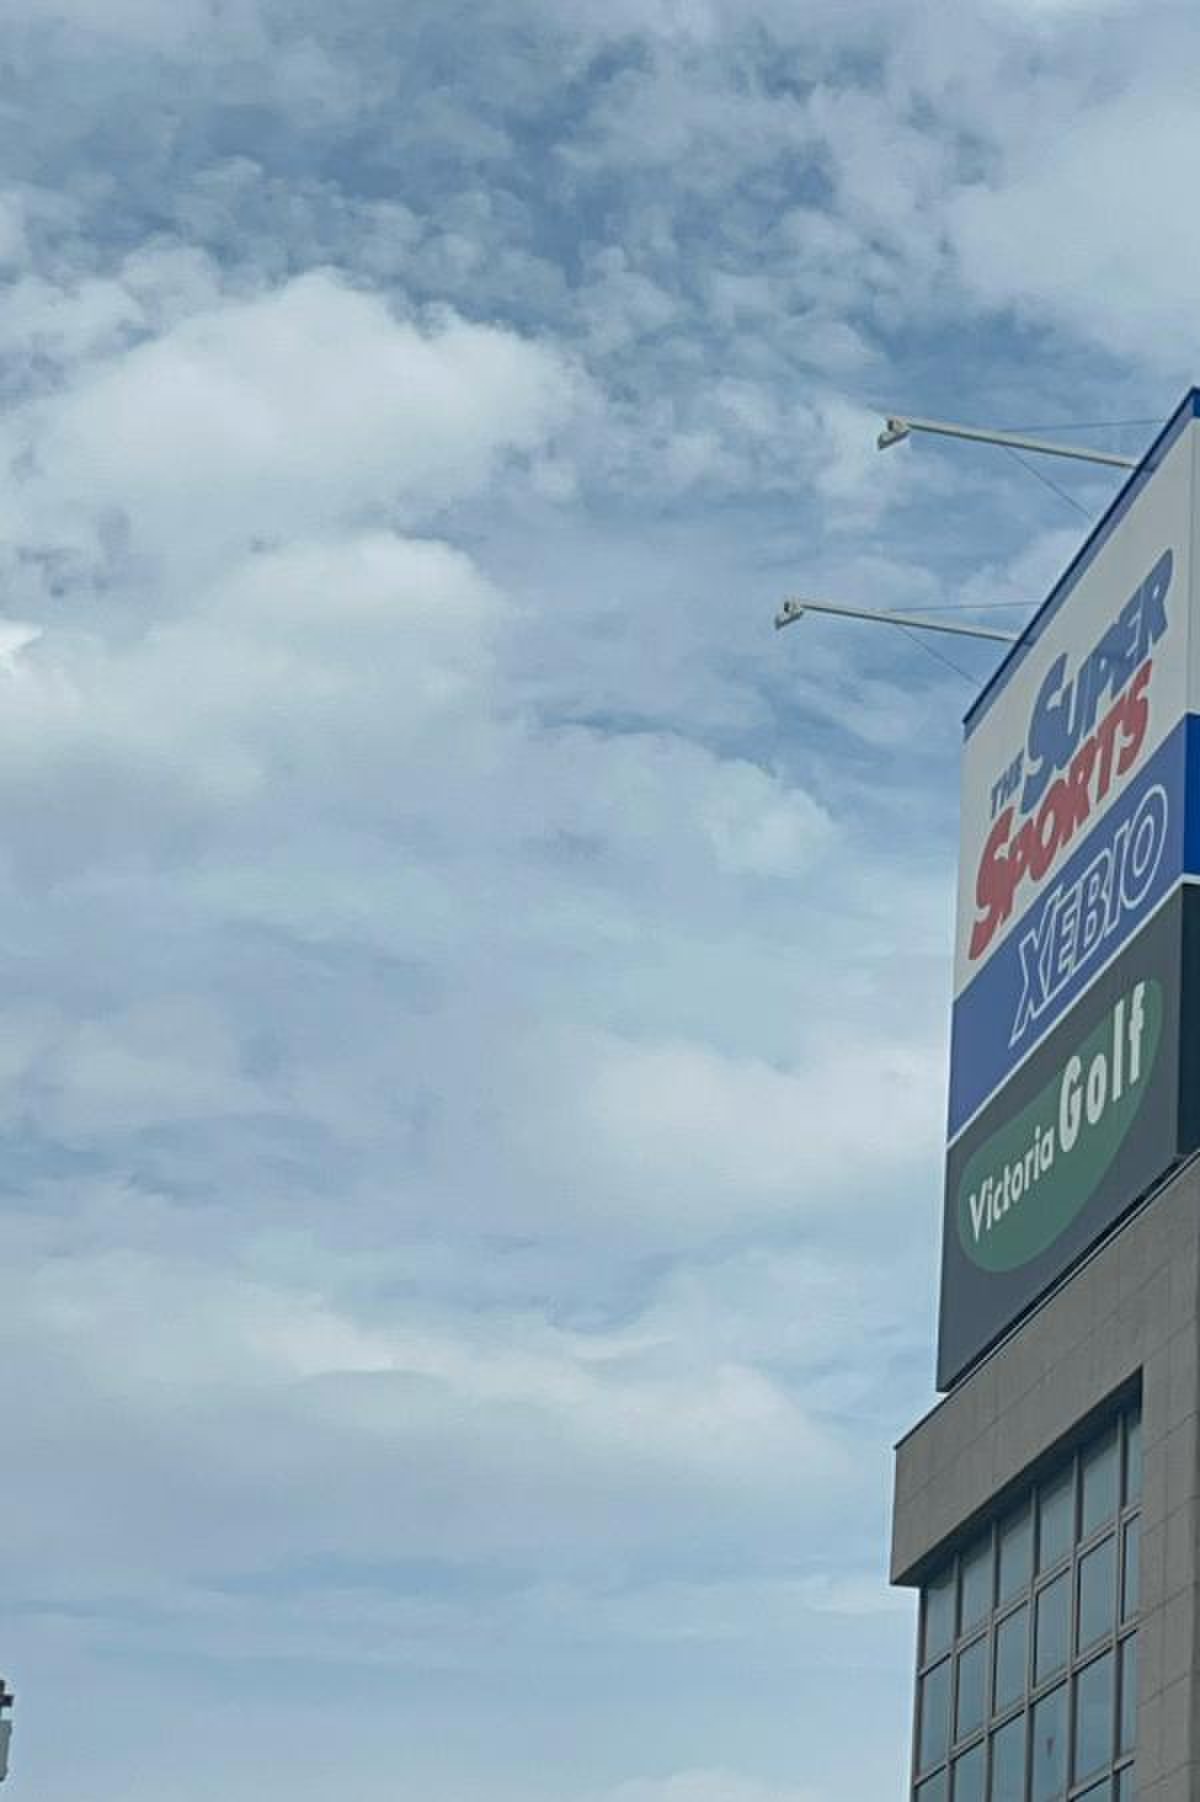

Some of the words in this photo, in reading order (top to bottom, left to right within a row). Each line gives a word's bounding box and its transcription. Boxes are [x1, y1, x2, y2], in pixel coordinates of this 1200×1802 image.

[969, 659, 1153, 961] SPORTS
[991, 748, 1024, 819] THE
[1020, 548, 1173, 815] SUPER
[1009, 783, 1168, 1049] XEBIO
[969, 1127, 1055, 1241] Victoria
[1059, 981, 1146, 1153] Golf
